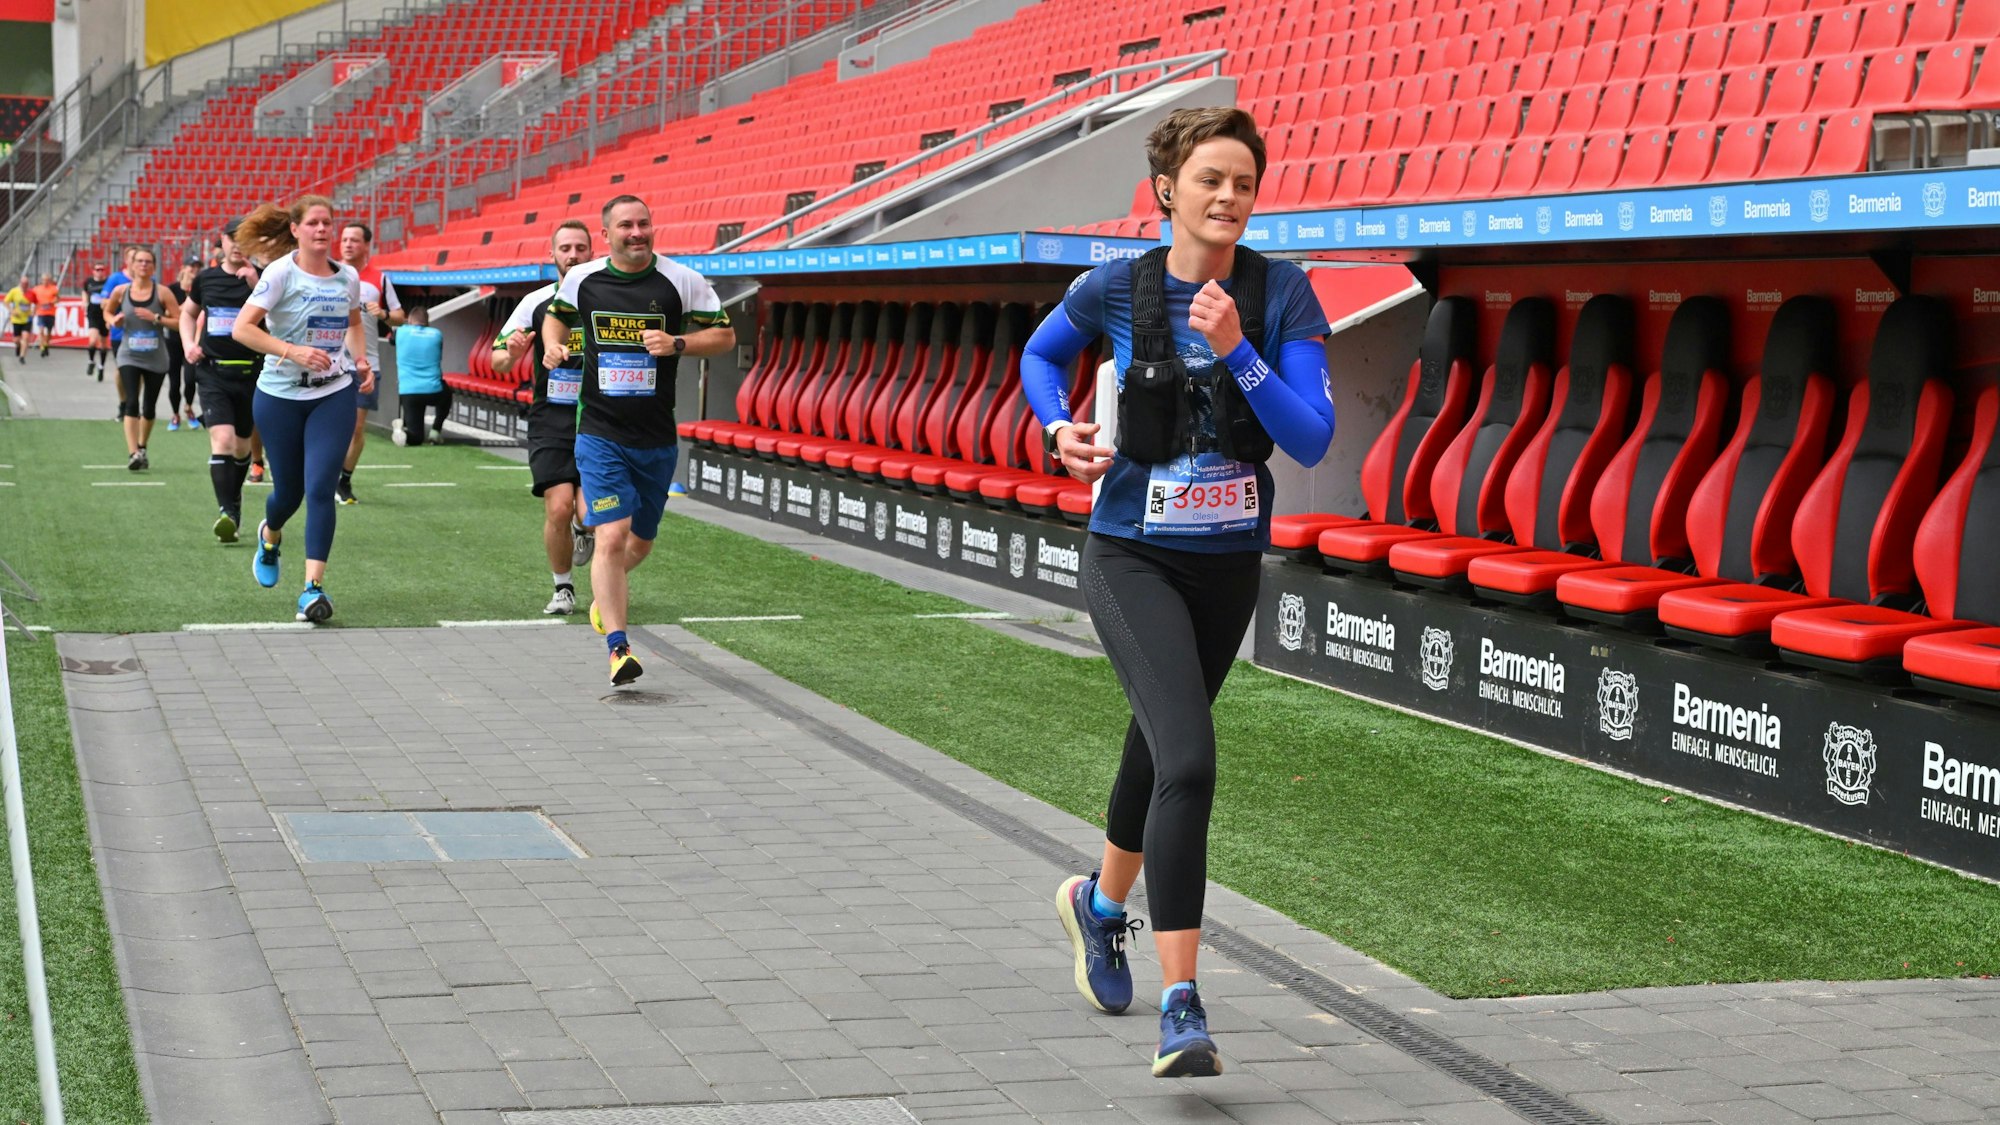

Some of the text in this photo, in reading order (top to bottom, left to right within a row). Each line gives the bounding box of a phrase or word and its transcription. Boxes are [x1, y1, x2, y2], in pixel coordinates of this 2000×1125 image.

[1744, 198, 1790, 219] Barmenia
[1849, 192, 1901, 214] Barmenia
[1488, 213, 1523, 230] Barmenia
[1565, 209, 1604, 228] Barmenia
[1650, 204, 1692, 224] Barmenia
[1298, 224, 1324, 238] Barmenia
[1356, 221, 1386, 236] Barmenia
[1419, 217, 1450, 233] Barmenia
[1746, 289, 1782, 302] Barmenia
[1856, 288, 1895, 302] Barmenia
[610, 318, 646, 329] BURG
[316, 330, 342, 341] 3434
[610, 370, 644, 382] 3734
[1238, 359, 1269, 392] OTSO
[1173, 484, 1238, 510] 3935
[1192, 512, 1219, 522] Olesja
[962, 520, 998, 552] Barmenia
[1038, 537, 1080, 572] Barmenia
[1326, 602, 1396, 650] Barmenia
[1326, 640, 1352, 662] EINFACH.
[1353, 648, 1394, 673] MENSCHLICH.
[1480, 637, 1565, 694] Barmenia
[1479, 680, 1564, 718] EINFACH. MENSCHLICH.
[1673, 682, 1782, 750] Barmenia
[1672, 731, 1780, 778] EINFACH. MENSCHLICH.
[1838, 758, 1860, 772] BAYER
[1922, 740, 2000, 806] Barm
[1830, 782, 1866, 802] Leverkusen
[1921, 798, 1974, 832] EINFACH.
